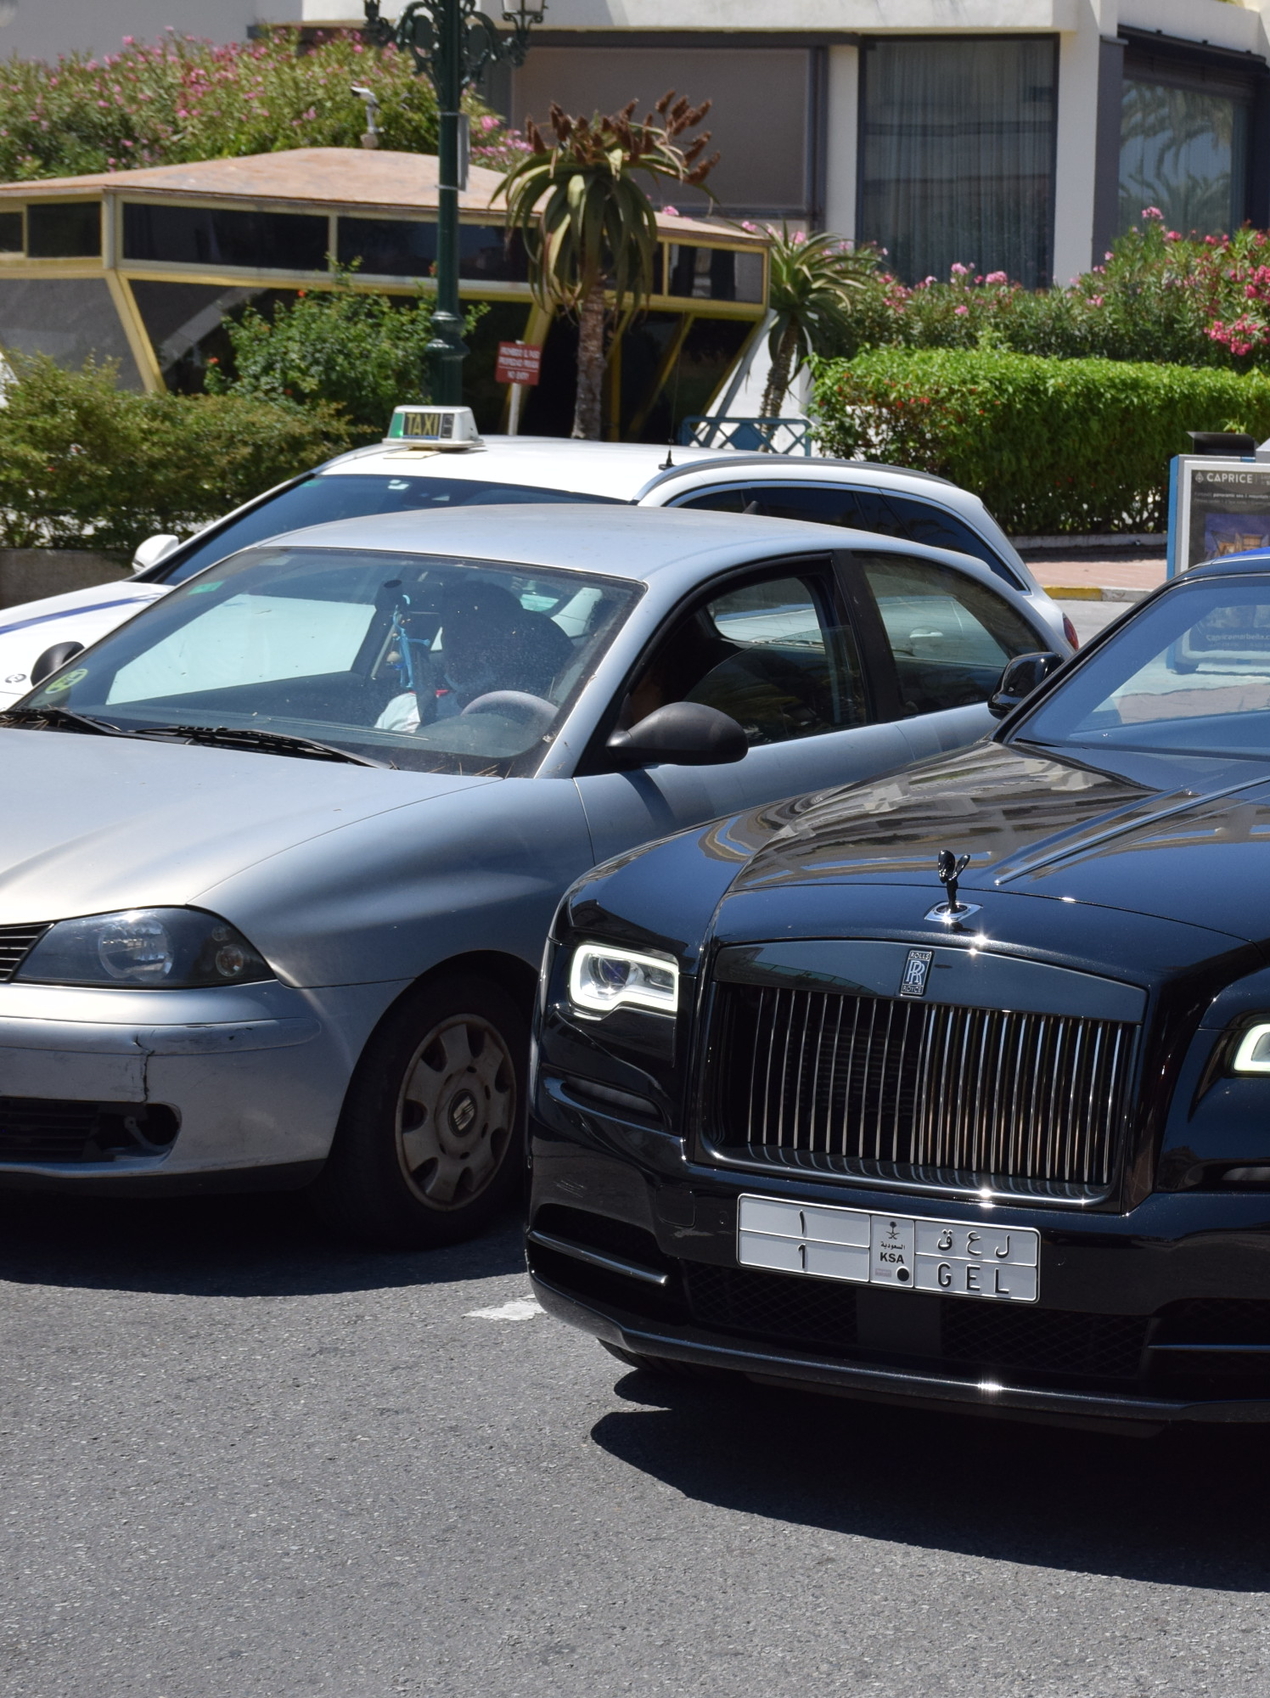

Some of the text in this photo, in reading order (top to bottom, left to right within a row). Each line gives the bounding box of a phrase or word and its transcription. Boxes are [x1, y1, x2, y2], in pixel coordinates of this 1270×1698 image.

[406, 413, 439, 436] TAXI
[1206, 472, 1253, 484] CAPRICE
[797, 1243, 807, 1270] 1
[880, 1251, 905, 1264] KSA
